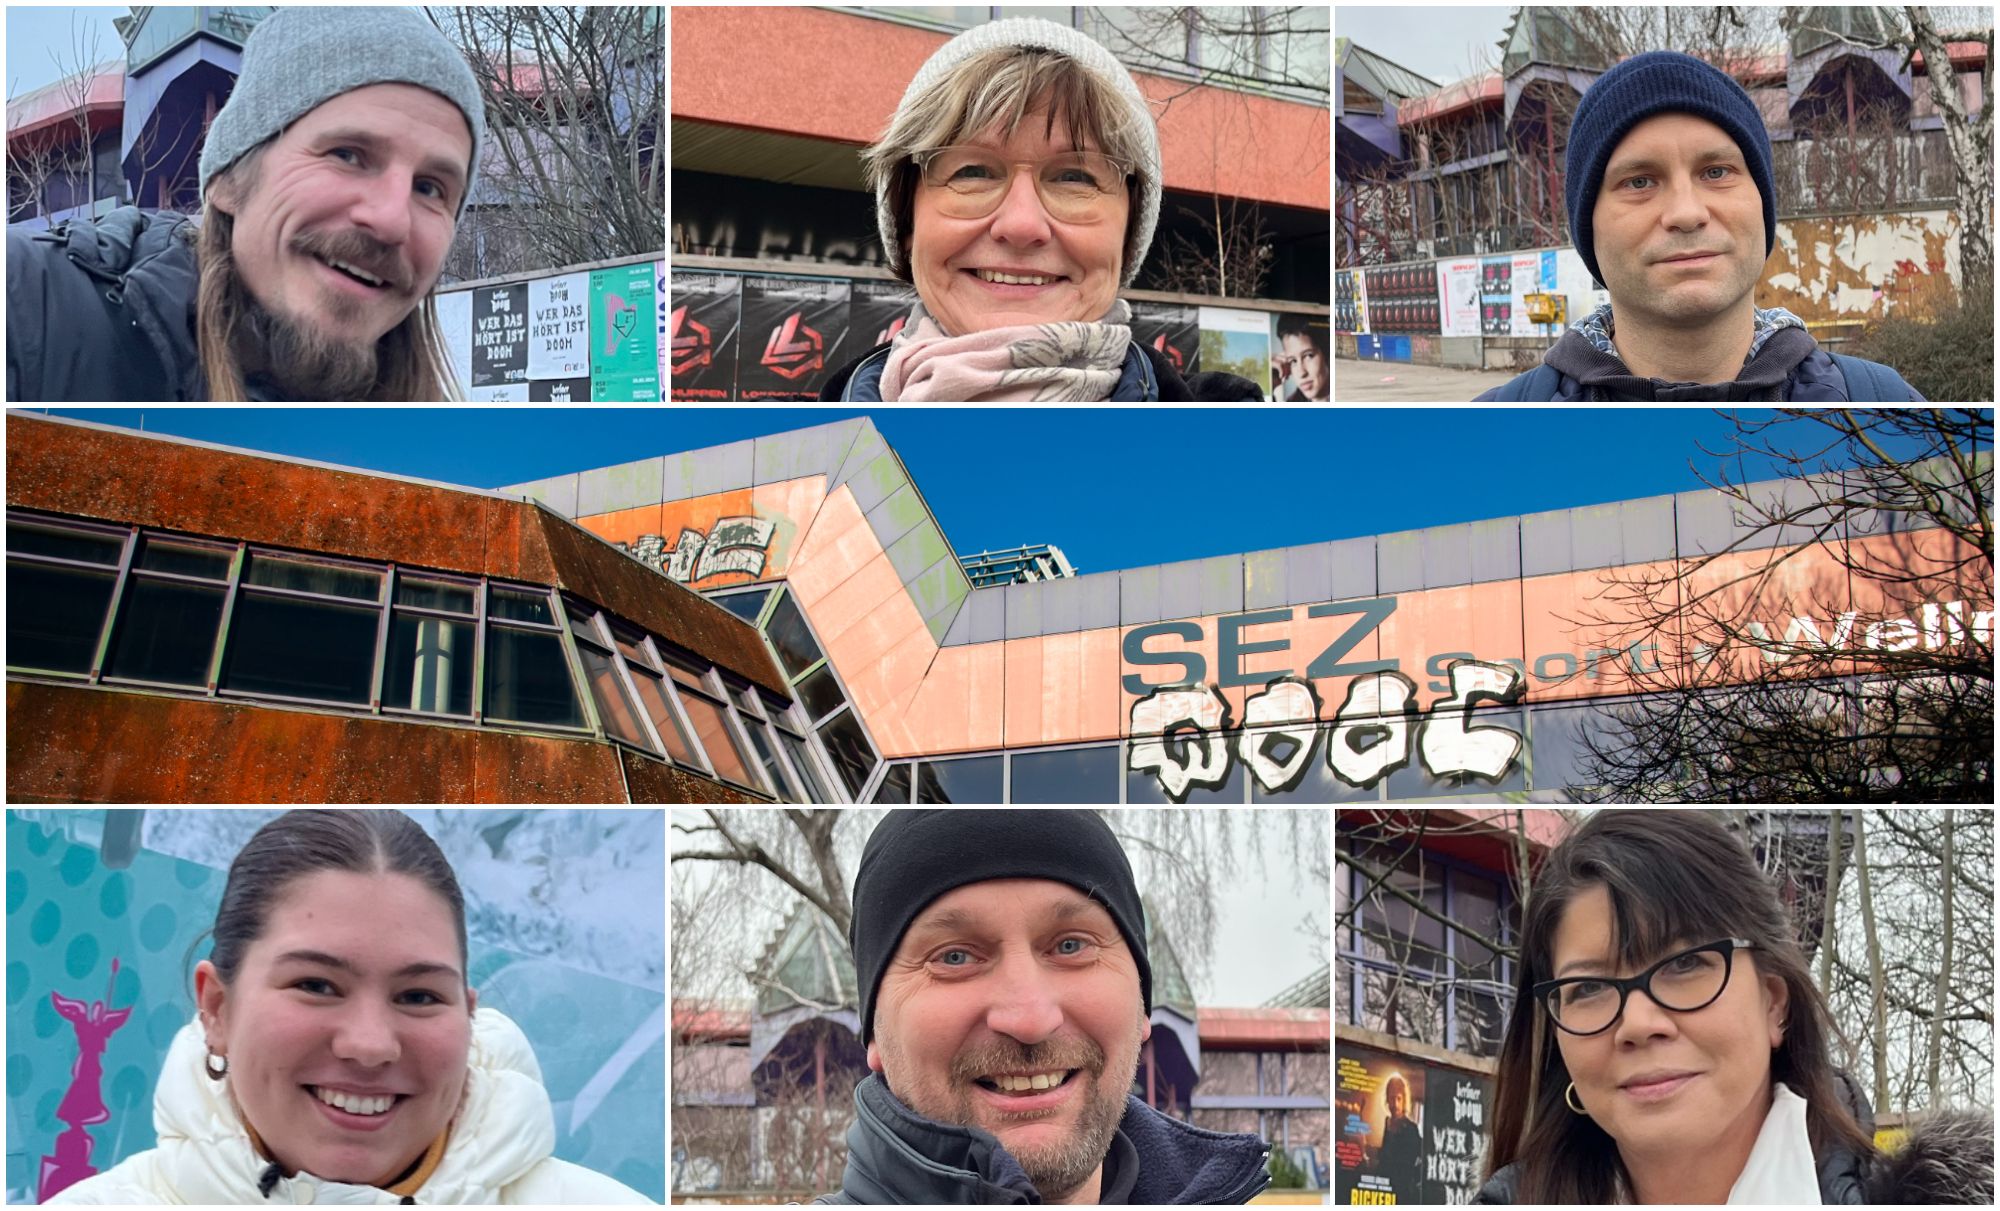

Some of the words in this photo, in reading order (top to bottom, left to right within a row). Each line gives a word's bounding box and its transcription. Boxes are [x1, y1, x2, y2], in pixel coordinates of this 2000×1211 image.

[478, 316, 501, 331] WER
[503, 313, 523, 328] DAS
[536, 308, 558, 322] WER
[562, 304, 582, 318] DAS
[475, 330, 503, 347] HÖRT
[506, 328, 526, 343] IST
[532, 322, 561, 338] HÖRT
[566, 320, 586, 334] IST
[487, 345, 513, 360] DOOM
[546, 337, 573, 352] DOOM
[1122, 596, 1400, 696] SEZ
[1425, 639, 1665, 693] Sort
[1433, 1126, 1467, 1155] WER
[1426, 1153, 1470, 1185] HÖRT
